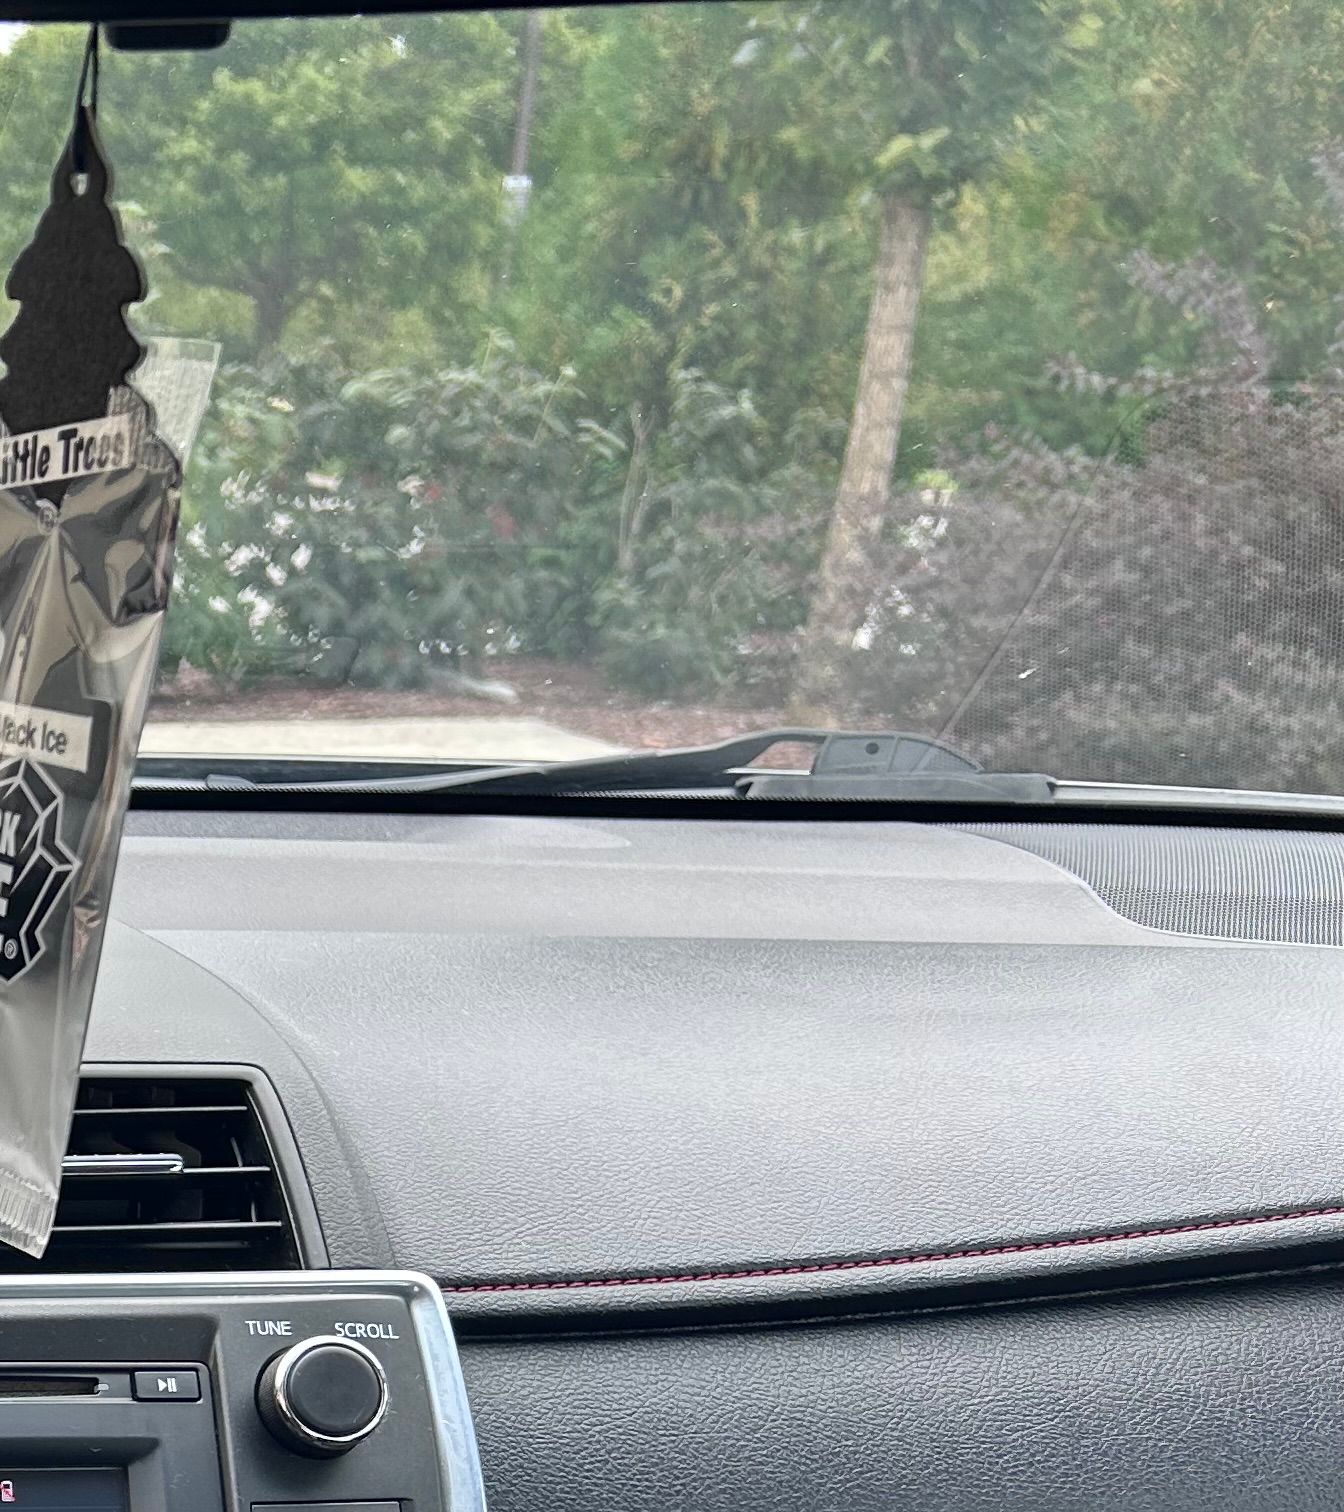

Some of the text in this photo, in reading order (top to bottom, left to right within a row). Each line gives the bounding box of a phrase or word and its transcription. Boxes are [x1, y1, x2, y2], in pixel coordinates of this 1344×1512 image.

[41, 721, 68, 754] Ice
[245, 1319, 293, 1337] TUNE
[334, 1321, 399, 1340] SCROLL
